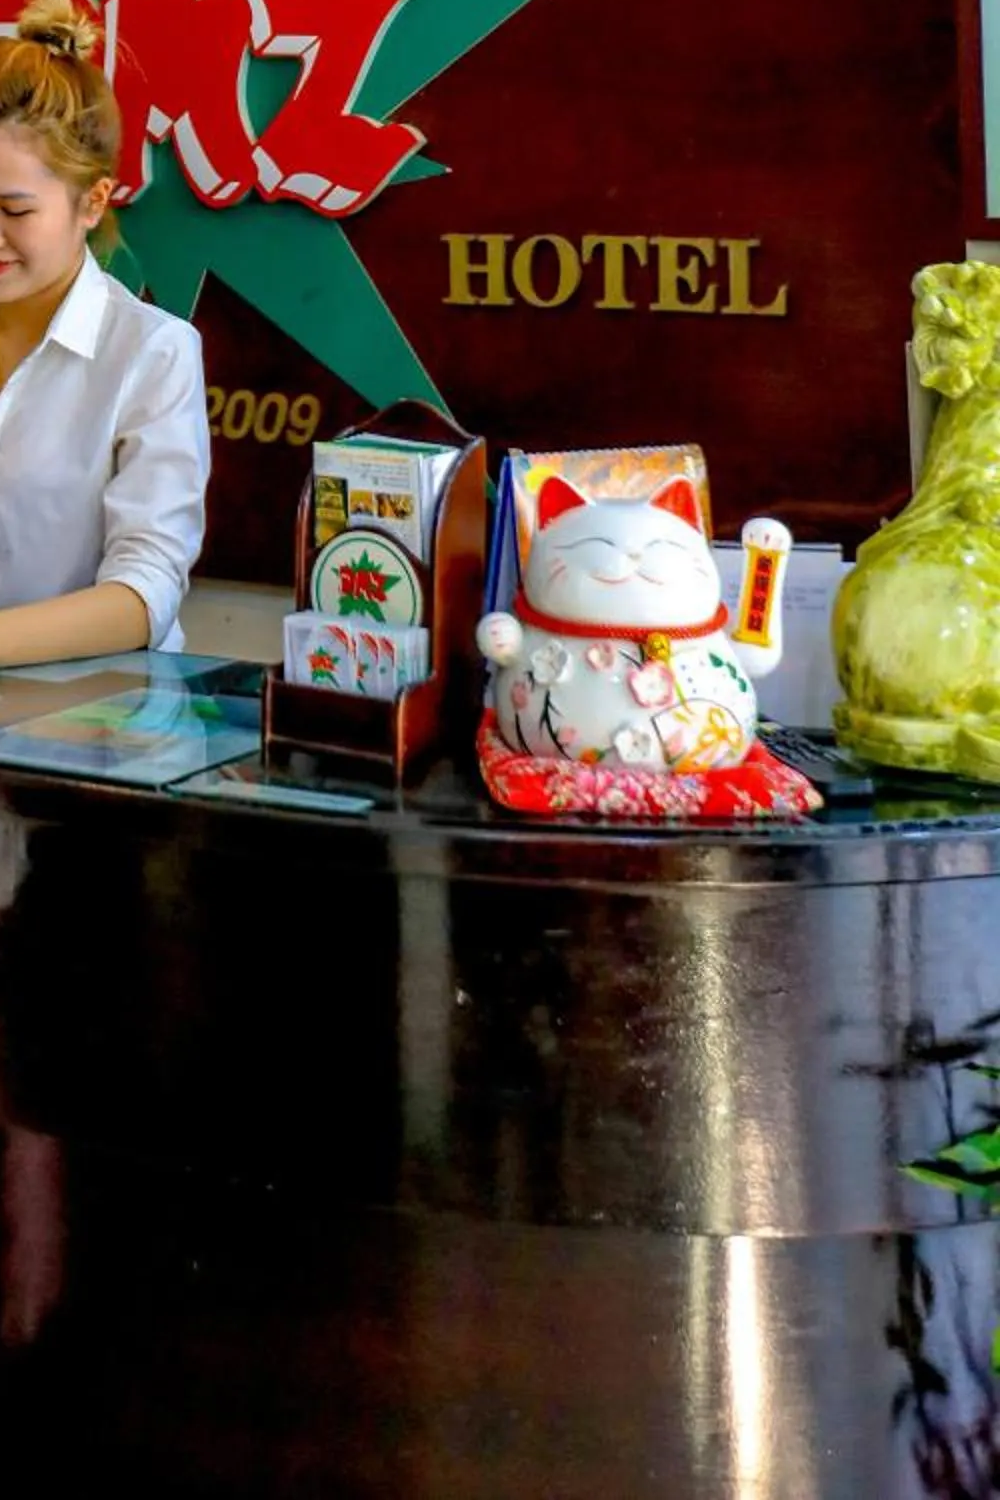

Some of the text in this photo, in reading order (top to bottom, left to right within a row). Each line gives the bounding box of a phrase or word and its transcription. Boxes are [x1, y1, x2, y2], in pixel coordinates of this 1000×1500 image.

[440, 233, 789, 317] HOTEL
[206, 386, 321, 447] 2009
[338, 565, 387, 604] DMZ
